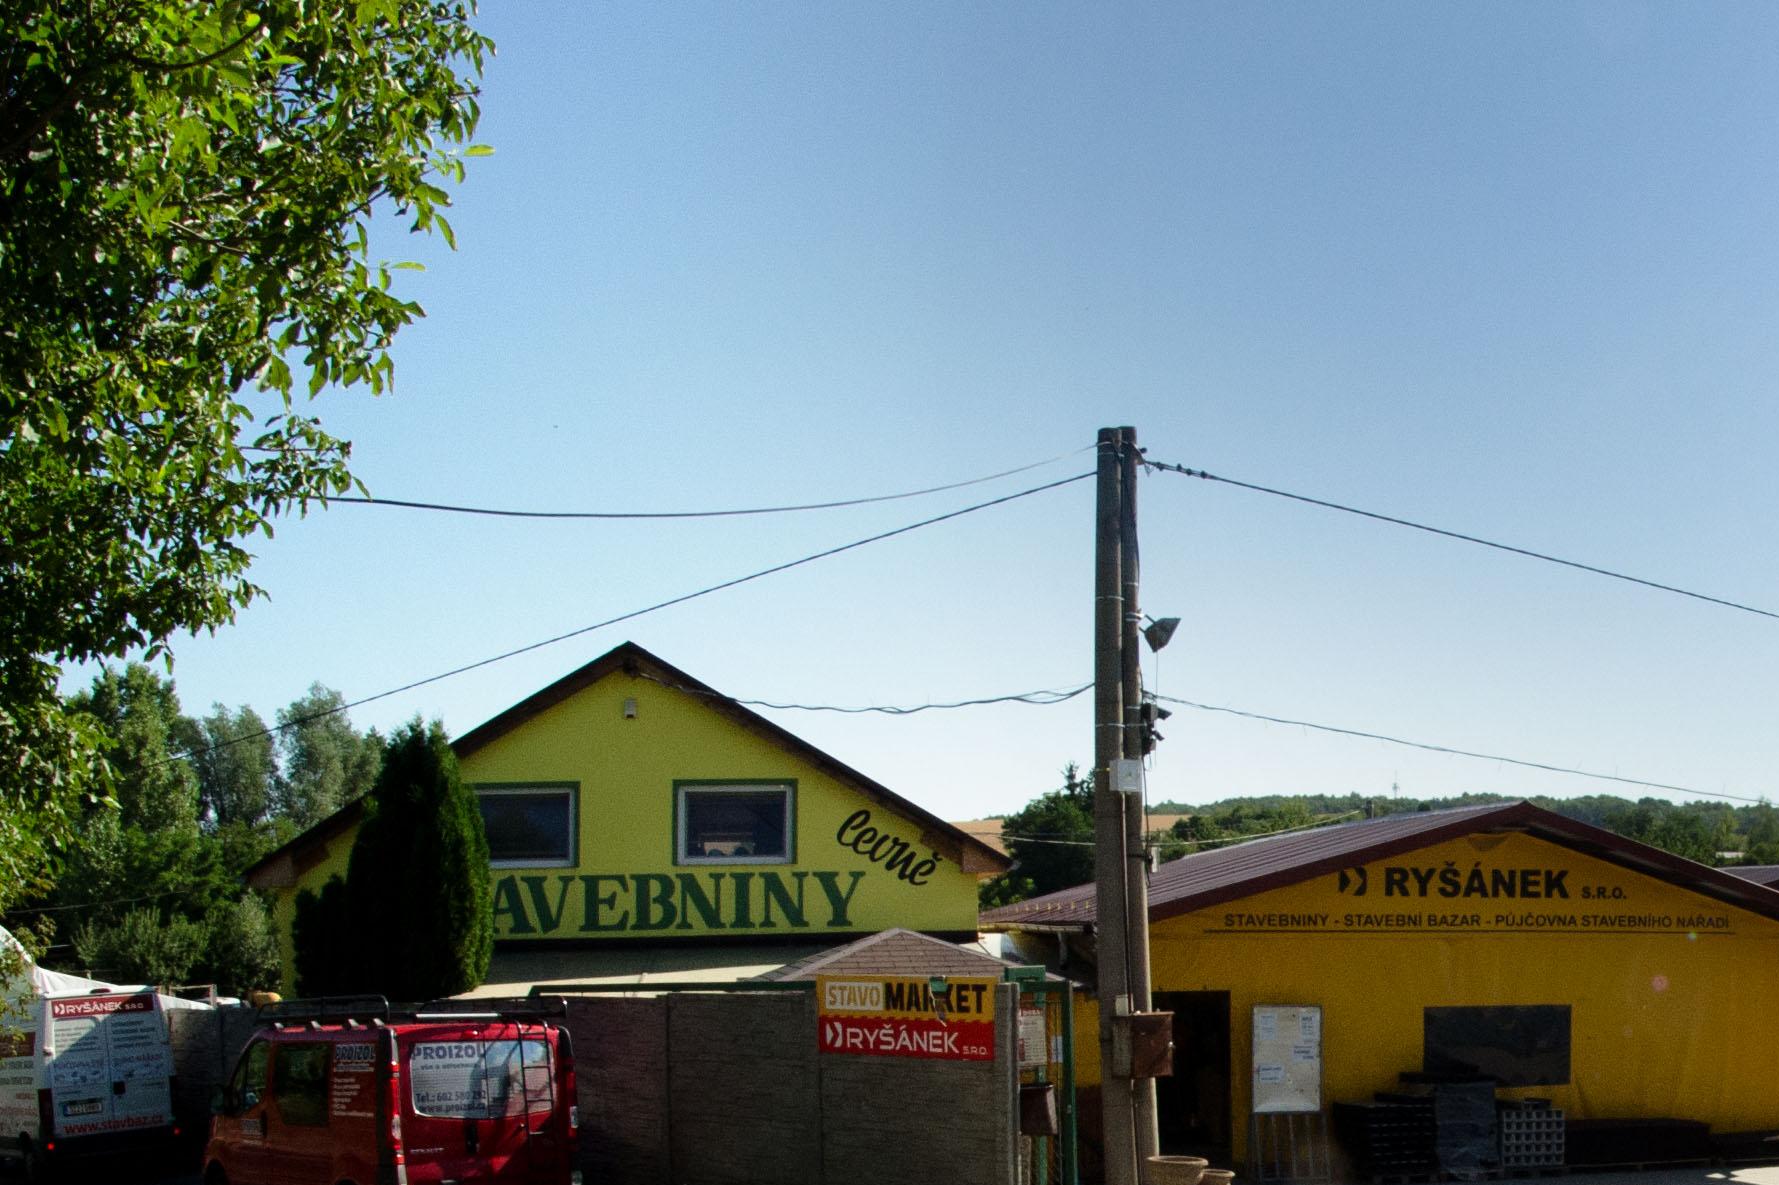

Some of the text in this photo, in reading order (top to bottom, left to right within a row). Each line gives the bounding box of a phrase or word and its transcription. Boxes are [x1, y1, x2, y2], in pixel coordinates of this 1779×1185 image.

[1384, 861, 1627, 900] RYŠÁNEK S.R.O.
[494, 871, 866, 935] AVEBNINY
[1224, 913, 1329, 927] STAVEBNINY
[1344, 912, 1422, 927] STAVEBNÍ
[1427, 914, 1481, 928] BAZAR
[1582, 913, 1672, 928] STAVEBNÍHO
[1676, 914, 1729, 929] NÁŘADÍ
[65, 999, 123, 1015] RYŠÁNEK
[827, 984, 882, 1008] STAVO
[846, 1024, 960, 1054] RYŠÁNEK
